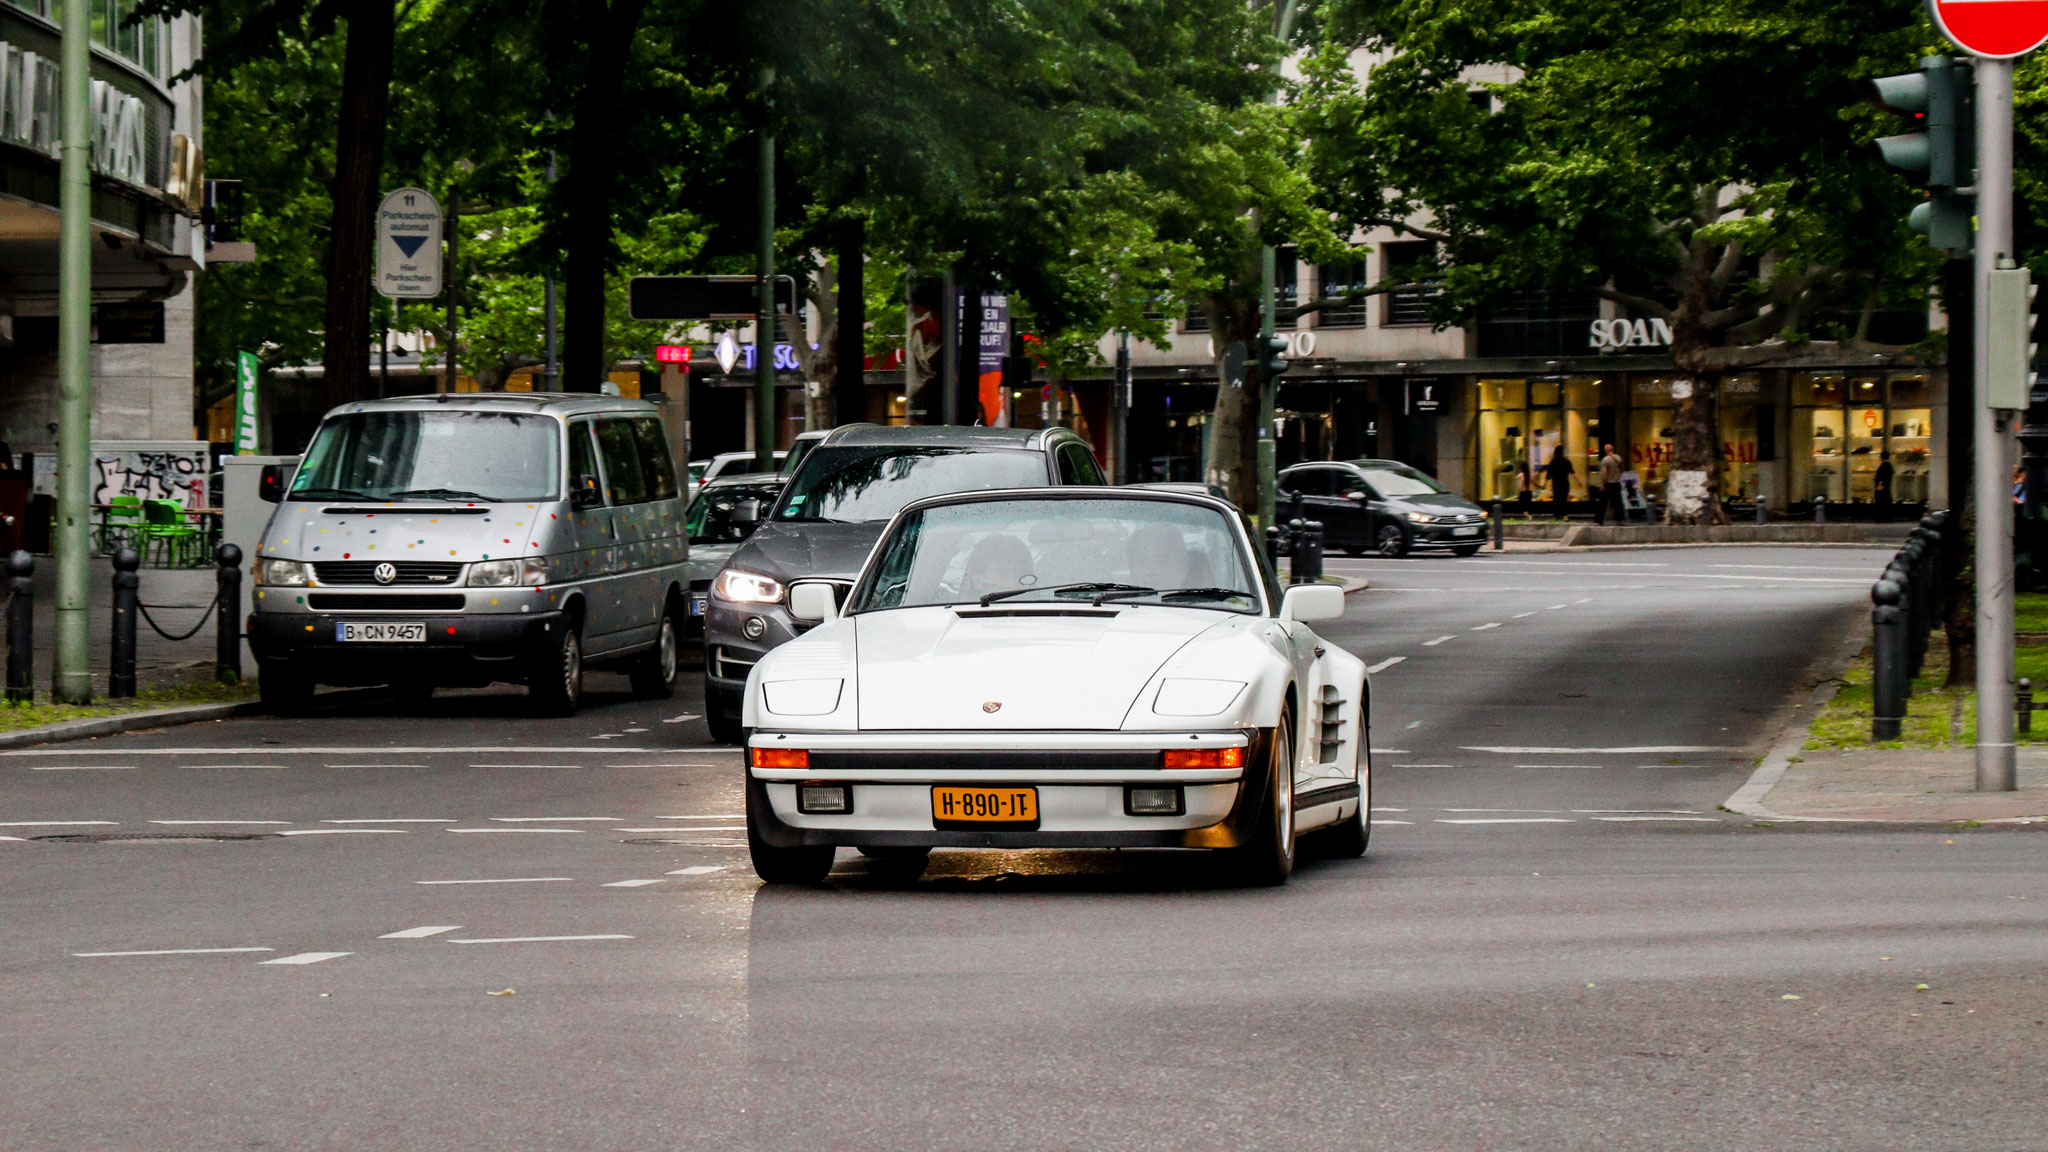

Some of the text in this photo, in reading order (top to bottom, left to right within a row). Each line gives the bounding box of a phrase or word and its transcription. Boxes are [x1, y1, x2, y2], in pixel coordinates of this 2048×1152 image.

[403, 195, 416, 206] 11
[390, 223, 430, 231] automat
[385, 273, 434, 281] Parkschein
[346, 625, 424, 640] B CN 9457
[942, 792, 1028, 817] H-890-JT
